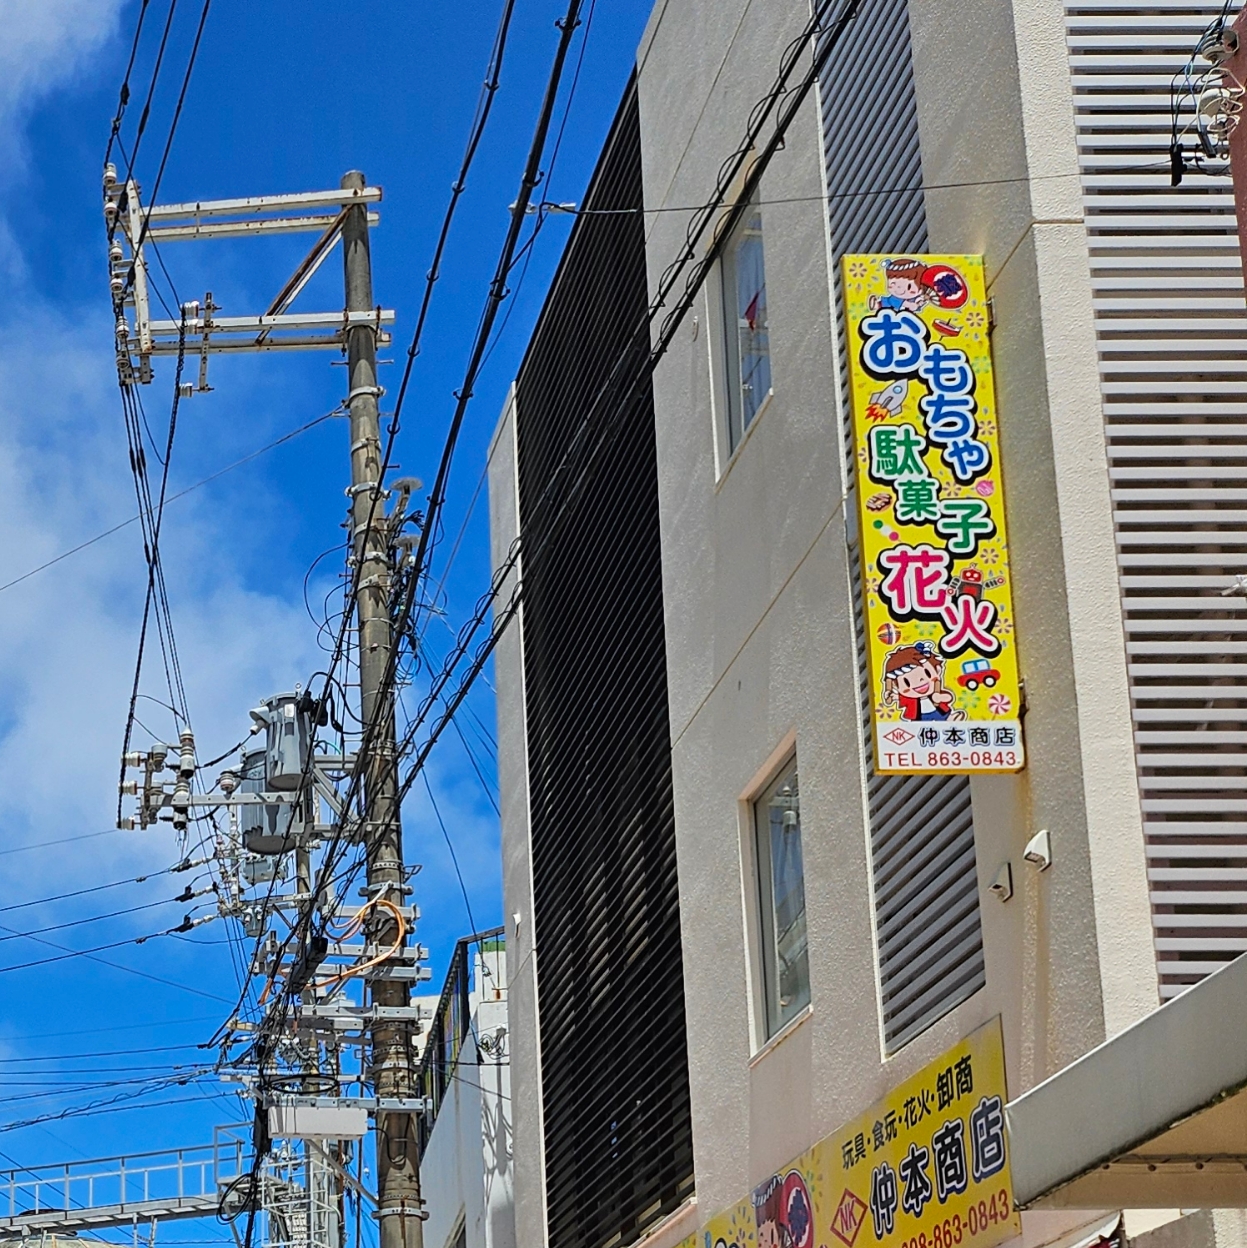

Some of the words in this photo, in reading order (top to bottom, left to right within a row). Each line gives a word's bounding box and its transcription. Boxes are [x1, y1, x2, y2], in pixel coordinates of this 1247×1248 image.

[863, 311, 989, 480] おもちゃ
[869, 424, 992, 553] 駄菓子
[882, 545, 1000, 654] 花火
[884, 752, 922, 767] TEL
[928, 751, 1016, 767] 863-0843
[918, 727, 1016, 747] 仲本商店
[869, 1095, 1006, 1241] 仲本商店
